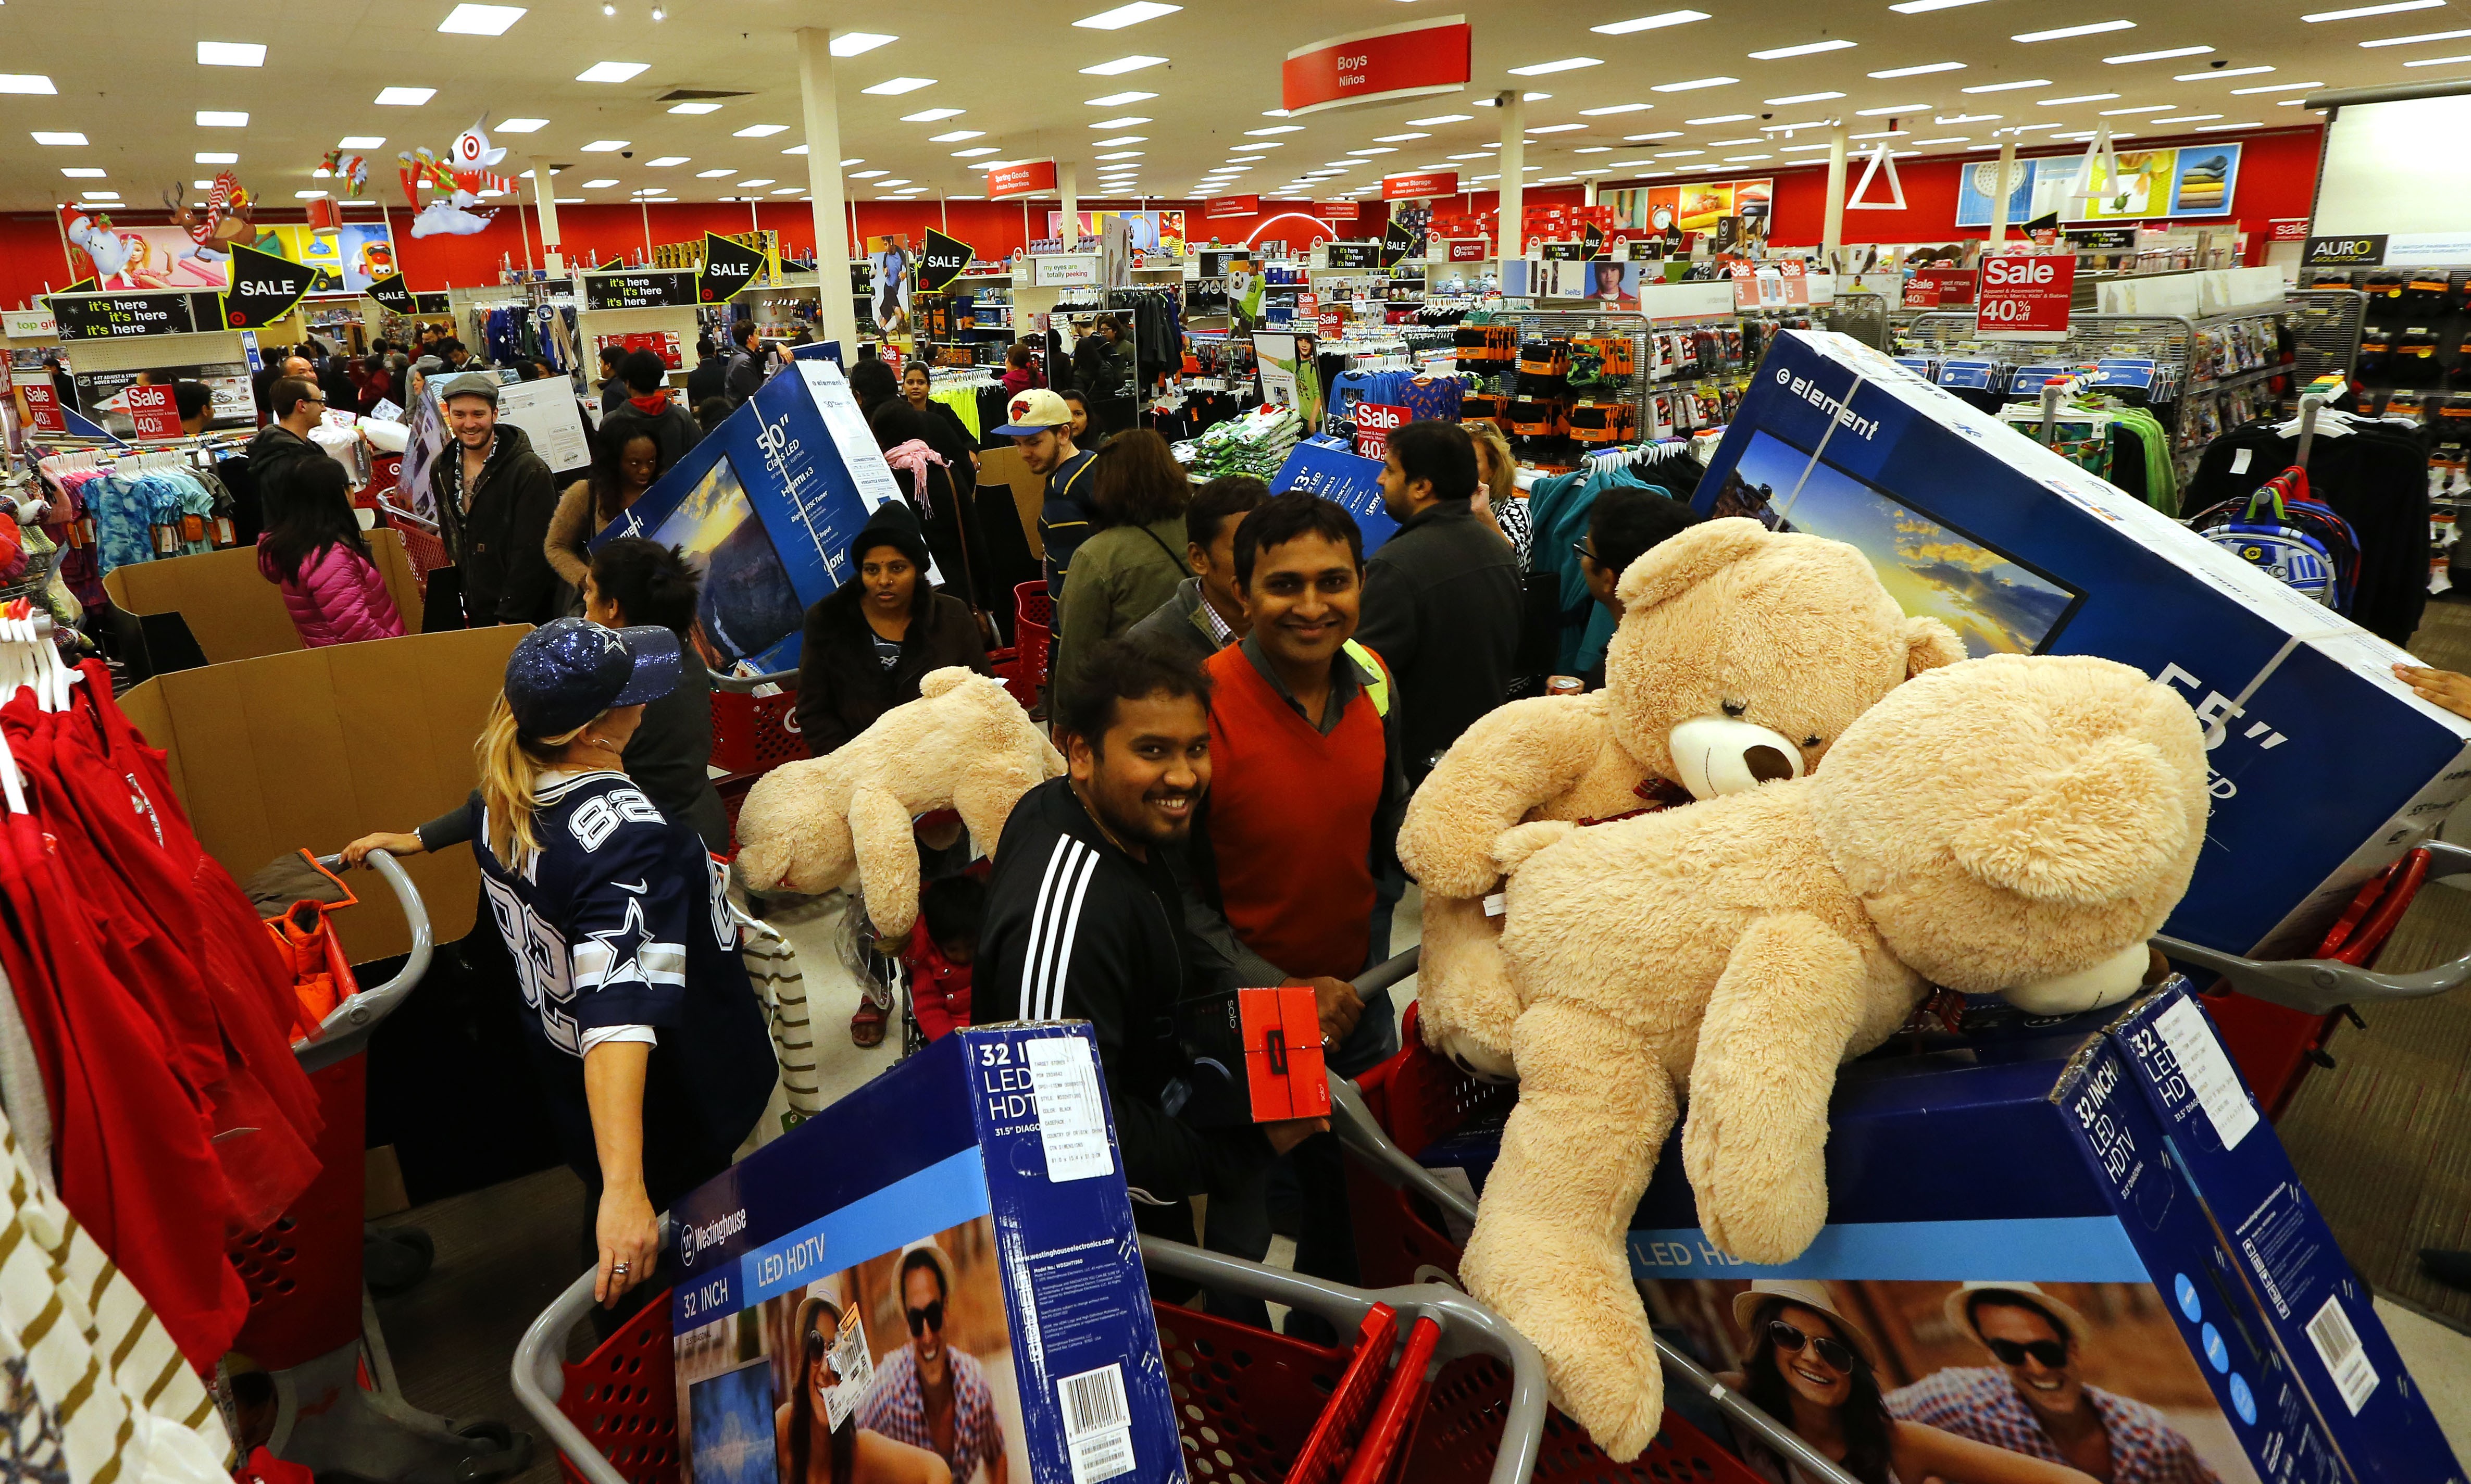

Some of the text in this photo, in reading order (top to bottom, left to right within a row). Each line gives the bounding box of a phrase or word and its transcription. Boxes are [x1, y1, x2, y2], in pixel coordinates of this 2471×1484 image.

[1338, 55, 1367, 70] Boys
[1339, 74, 1365, 87] Niños
[995, 170, 1029, 183] Sporting Goods
[1387, 241, 1406, 250] SALE
[2313, 240, 2372, 255] AURO
[710, 263, 749, 277] SALE
[928, 256, 960, 268] SALE
[1729, 261, 1751, 277] Sale
[1781, 261, 1801, 276] Sale
[1985, 259, 2054, 285] Sale
[240, 279, 296, 296] SALE
[609, 277, 650, 288] it's here
[1908, 279, 1934, 289] Sale
[378, 290, 405, 301] SALE
[623, 286, 662, 296] it's here
[1299, 294, 1314, 303] Sale
[89, 299, 148, 313] it's here
[607, 297, 647, 307] it's here
[109, 310, 167, 323] it's here
[1319, 314, 1338, 325] Sale
[2016, 311, 2030, 321] off
[17, 320, 57, 330] top gif
[86, 323, 145, 336] it's here
[882, 346, 896, 361] Sale
[26, 386, 49, 403] Sale
[129, 388, 165, 407] Sale
[1358, 404, 1400, 429] Sale
[1790, 377, 1879, 441] element
[755, 413, 790, 459] 50"
[784, 439, 800, 457] LED
[805, 466, 814, 478] x3
[1311, 472, 1322, 485] LED
[1330, 476, 1336, 484] x3
[1336, 477, 1352, 500] ATSC Tuner
[790, 510, 805, 523] Digit
[805, 497, 816, 512] ATSC
[814, 490, 828, 504] Tuner
[1350, 491, 1364, 509] PC Input
[618, 515, 644, 538] ment
[819, 525, 832, 539] Input
[568, 788, 667, 853] 82
[481, 868, 583, 1058] 82
[2131, 1028, 2157, 1057] 32
[979, 1042, 1012, 1067] 32
[2144, 1045, 2179, 1083] LED
[984, 1067, 1034, 1093] LED
[2074, 1061, 2118, 1129] 32 INCH
[2158, 1070, 2187, 1108] HD
[989, 1093, 1038, 1120] HDT
[2185, 1098, 2201, 1114] DIAGO
[995, 1123, 1041, 1137] 31.5" DIAGO
[2089, 1114, 2115, 1157] LED
[2104, 1126, 2136, 1184] HDTV
[695, 1208, 746, 1252] Westinghouse
[1014, 1238, 1115, 1263] www.westinghouseelectronics.com
[1634, 1242, 1692, 1266] LED
[757, 1232, 825, 1288] LED HDTV
[683, 1277, 728, 1319] 32 INCH
